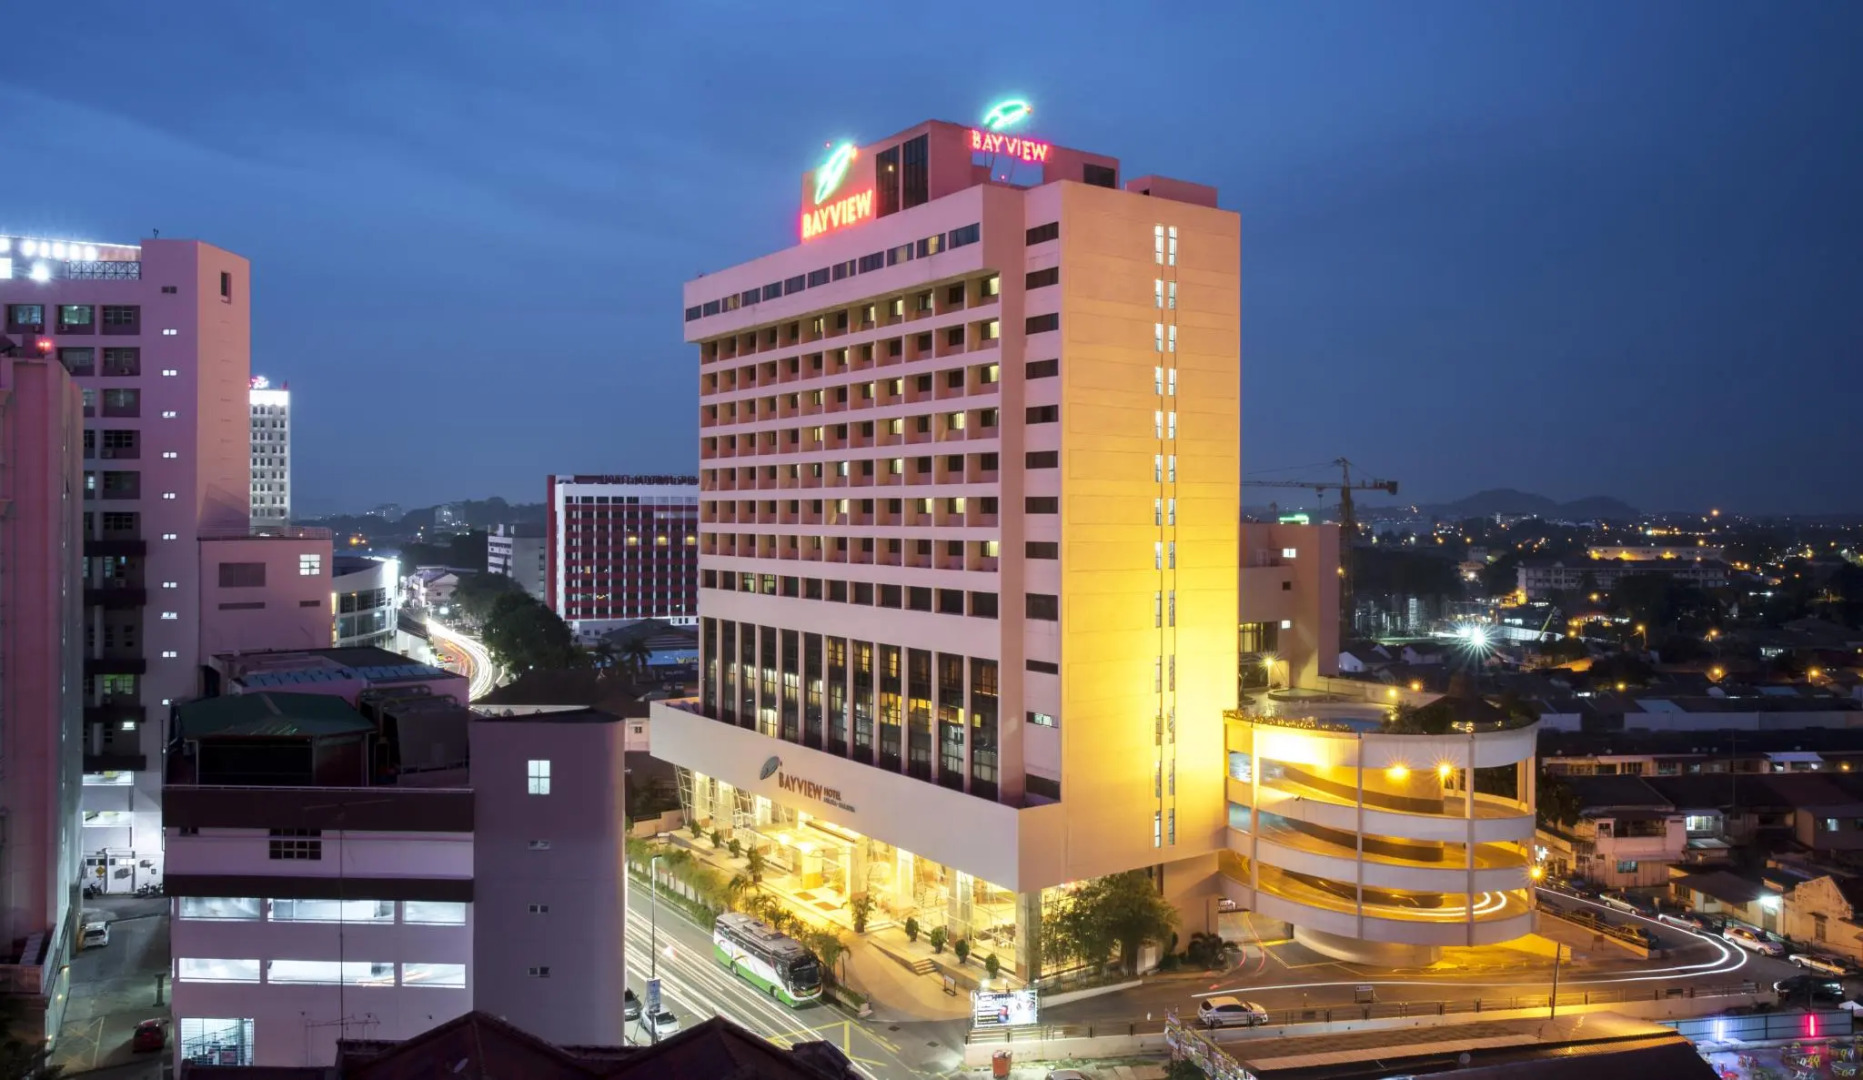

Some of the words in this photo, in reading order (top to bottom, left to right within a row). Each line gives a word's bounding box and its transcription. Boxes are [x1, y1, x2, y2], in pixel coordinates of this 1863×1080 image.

[970, 129, 1048, 161] BAYVIEW
[802, 190, 872, 238] BAYVIEW
[779, 772, 823, 800] BAYVIEW
[823, 787, 841, 800] HOTEL
